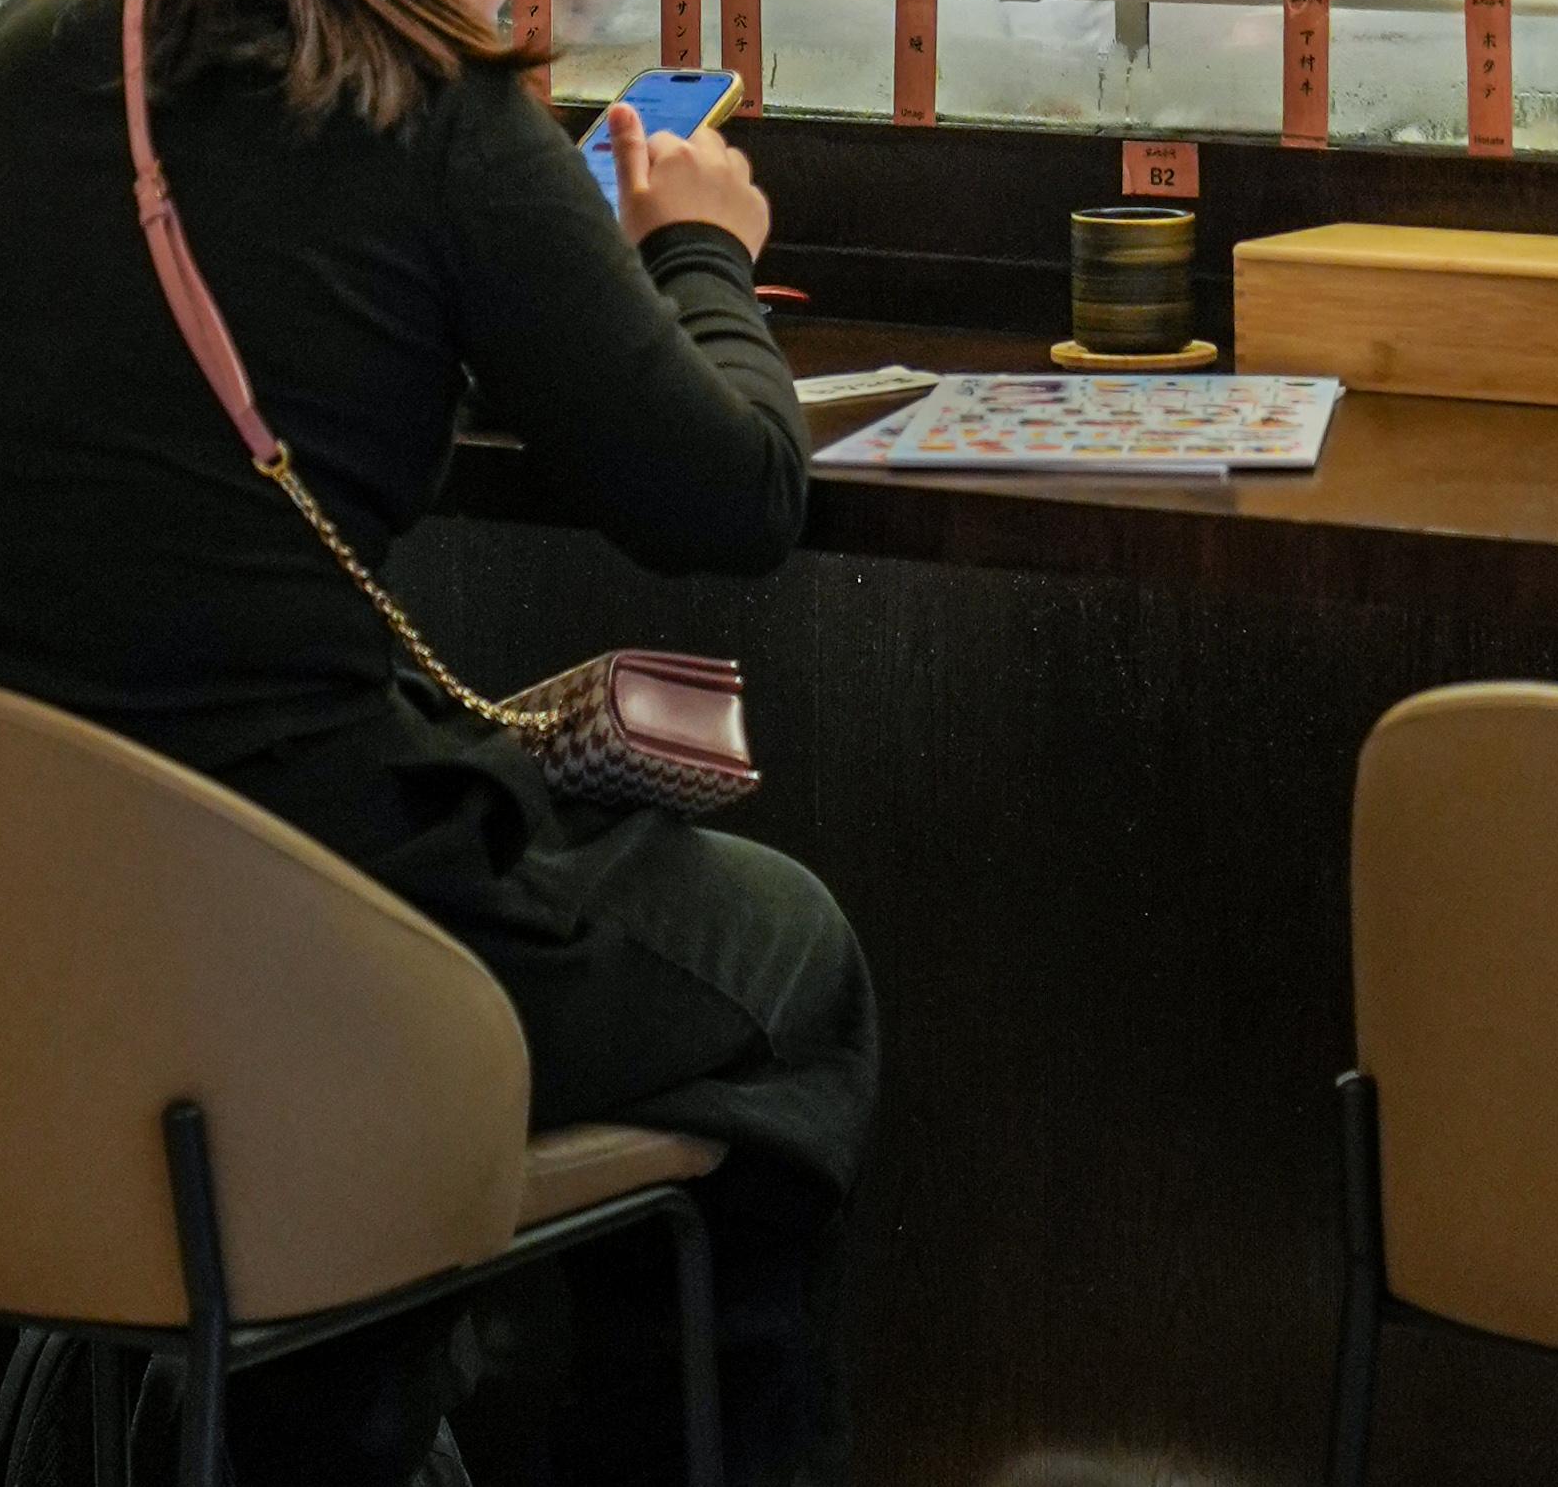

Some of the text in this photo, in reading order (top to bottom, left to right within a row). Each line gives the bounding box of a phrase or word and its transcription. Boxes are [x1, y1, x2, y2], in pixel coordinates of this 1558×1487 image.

[674, 0, 690, 62] サンマ
[732, 12, 749, 53] 穴子
[1482, 31, 1498, 100] ホタテ
[1149, 166, 1176, 187] B2
